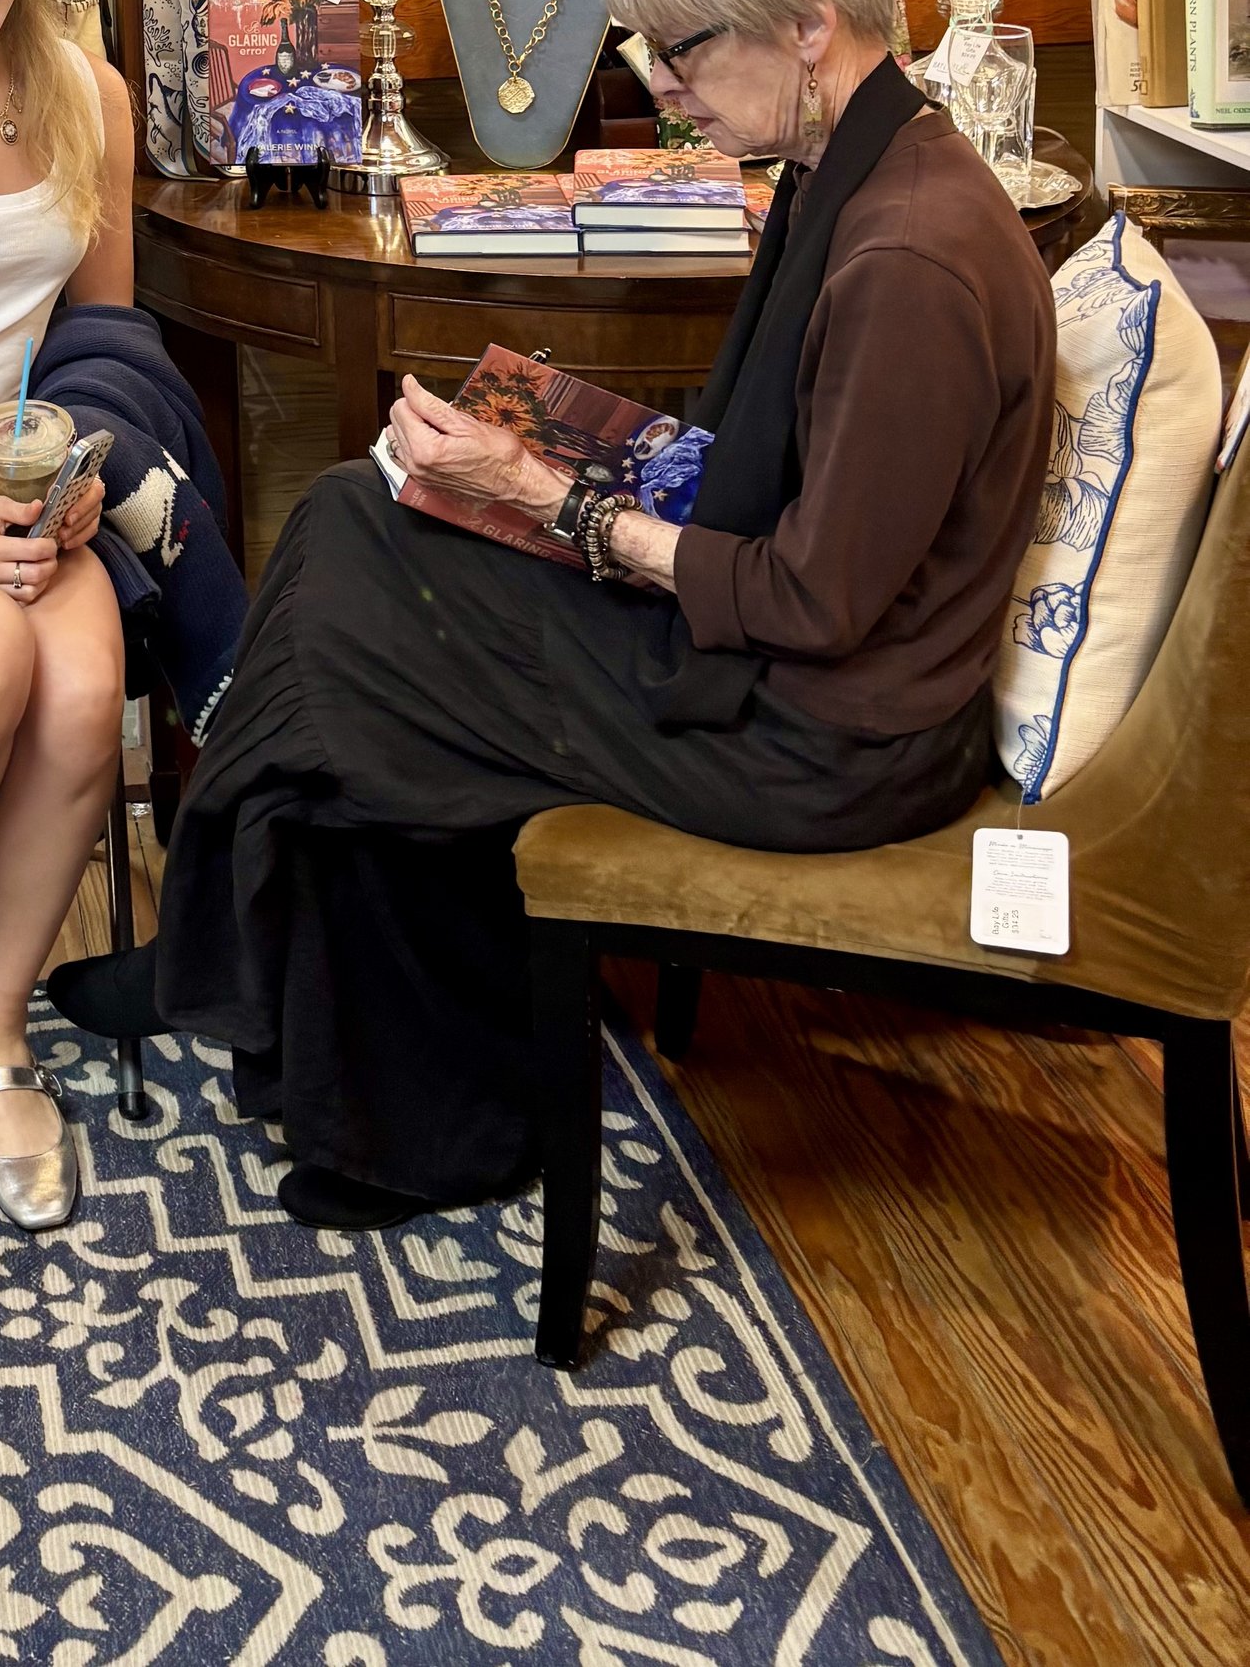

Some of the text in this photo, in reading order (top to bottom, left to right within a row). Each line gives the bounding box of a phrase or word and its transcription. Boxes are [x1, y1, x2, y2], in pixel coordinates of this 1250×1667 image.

[228, 33, 278, 48] GLARING
[239, 47, 267, 56] error
[1189, 20, 1198, 72] PLANTS
[482, 524, 551, 558] GLARING
